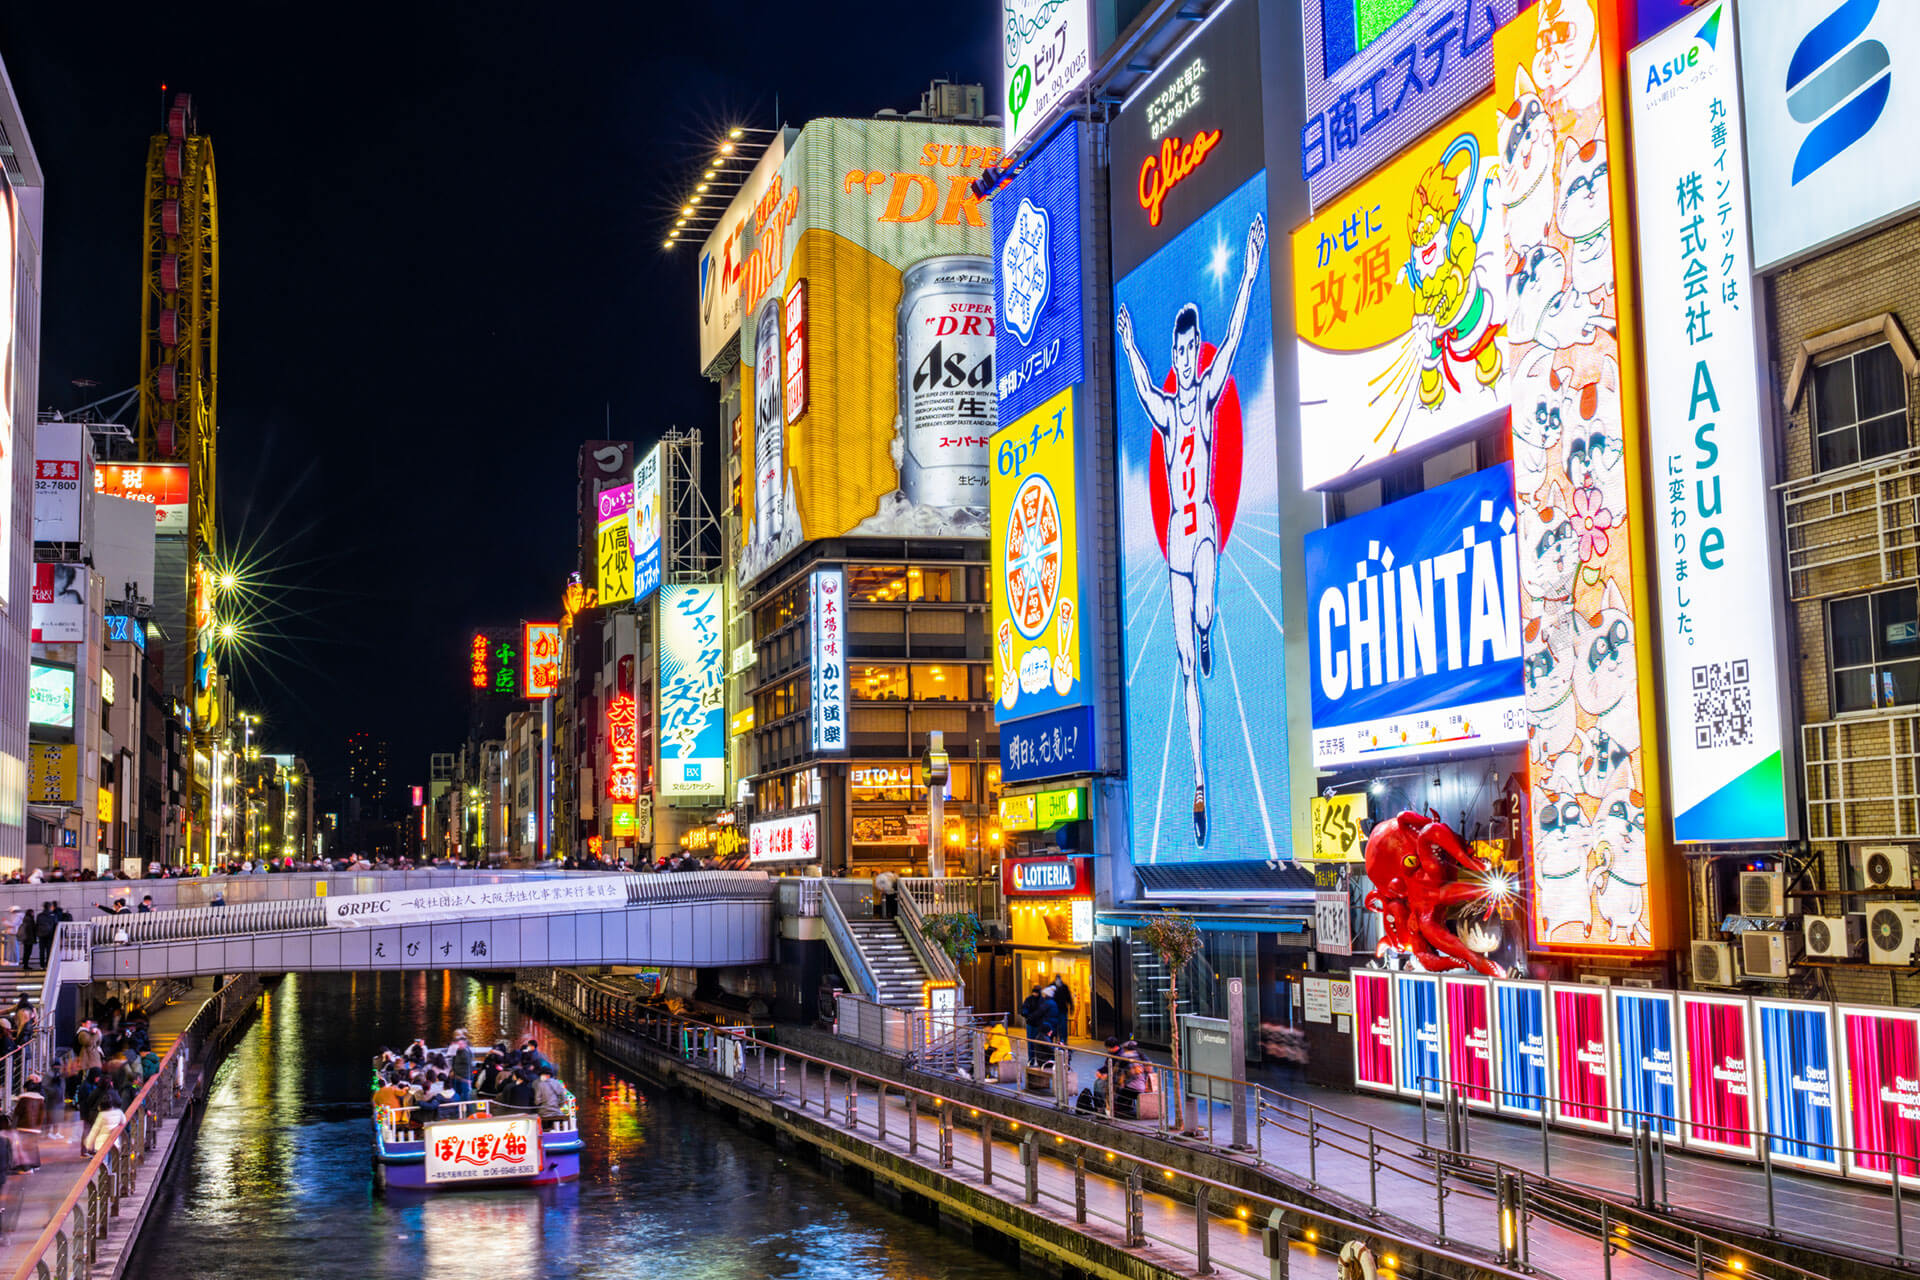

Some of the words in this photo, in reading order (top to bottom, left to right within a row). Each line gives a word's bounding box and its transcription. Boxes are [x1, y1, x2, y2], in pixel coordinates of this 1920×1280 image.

[1034, 20, 1067, 87] ピップ
[1646, 45, 1699, 93] Asue
[1147, 58, 1206, 122] すこやかな毎日、
[1152, 86, 1200, 139] ゆたかな人生
[1302, 0, 1496, 181] 日商エステム
[1139, 129, 1220, 226] Glico
[1708, 97, 1739, 312] 丸善インテックは、
[1316, 205, 1383, 268] かぜに
[1676, 170, 1713, 346] 株式会社
[949, 303, 993, 313] SUPER
[1310, 236, 1392, 338] 改源
[958, 398, 987, 418] 生
[36, 462, 76, 478] 募集
[1180, 429, 1198, 536] グリコ
[1688, 359, 1725, 570] Asue
[601, 529, 615, 601] バイト
[615, 525, 629, 595] 高収入
[1667, 453, 1694, 648] に変わりました。
[823, 599, 838, 657] 本場の味
[1318, 518, 1523, 700] CHINTAI
[677, 587, 723, 709] シャッターは
[822, 662, 841, 743] かに道楽
[607, 696, 637, 799] 大阪王将
[686, 768, 699, 777] BX
[1008, 726, 1079, 771] 明日を、元気に!
[401, 895, 476, 910] 一般社団法人
[1024, 865, 1071, 886] LOTTERIA
[375, 940, 487, 957] えびす橋
[435, 1132, 527, 1166] ぽんぽん船
